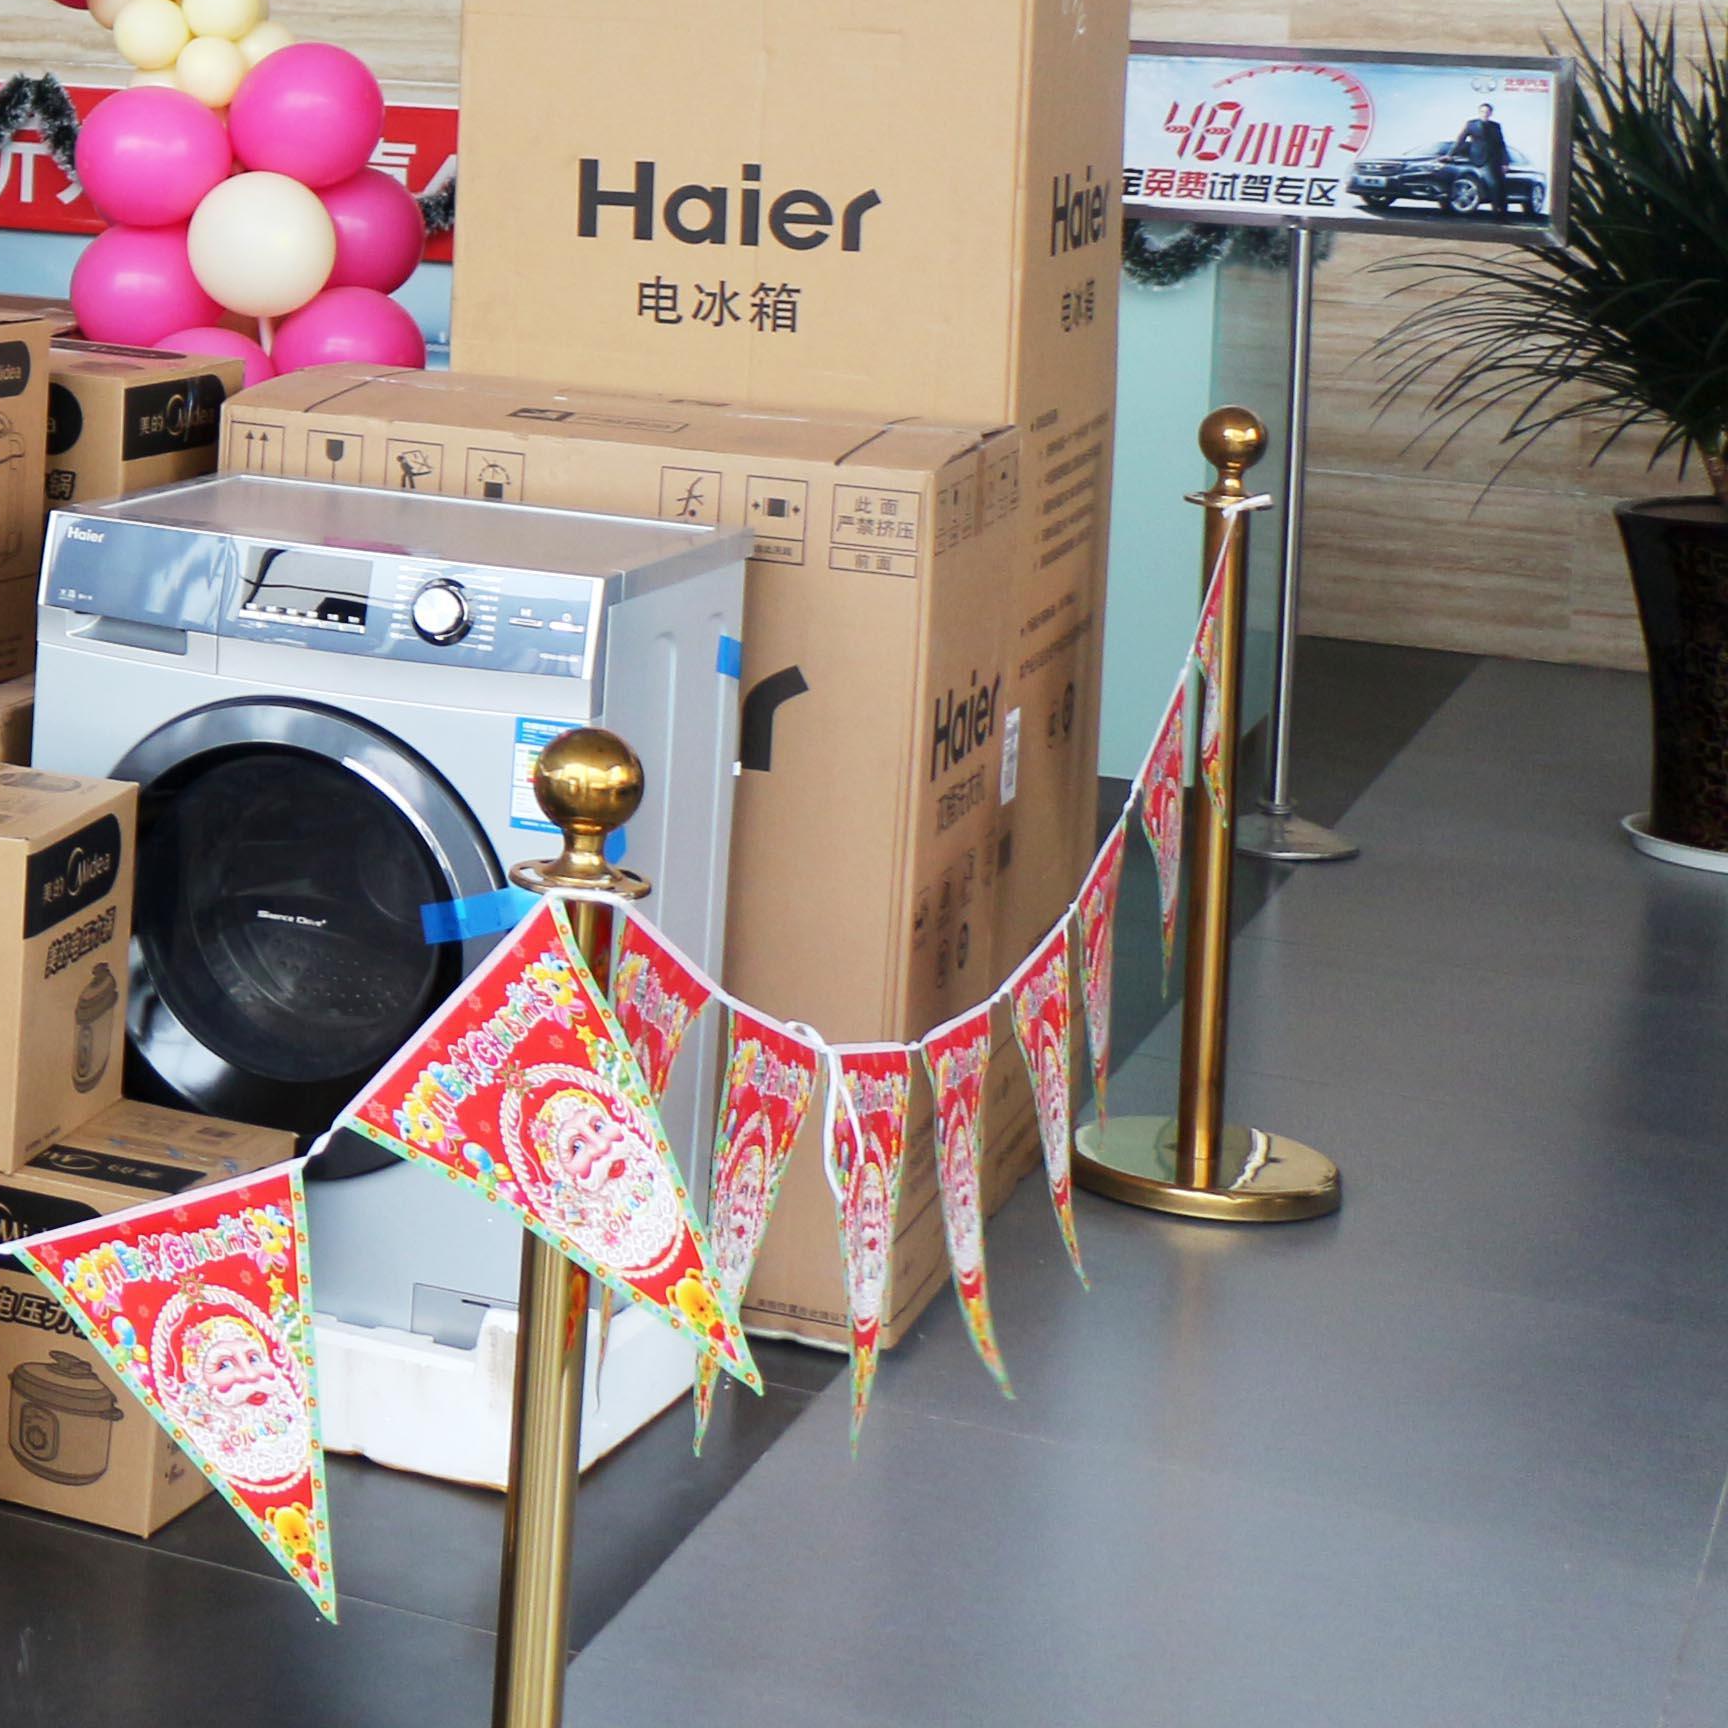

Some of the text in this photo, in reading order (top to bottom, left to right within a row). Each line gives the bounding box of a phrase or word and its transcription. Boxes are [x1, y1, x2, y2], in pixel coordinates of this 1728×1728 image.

[1163, 100, 1336, 169] 48小时
[577, 158, 883, 253] Haier
[1050, 164, 1112, 258] Haier
[637, 274, 803, 334] 电冰箱
[138, 413, 165, 438] 美的
[66, 526, 106, 545] Haier
[835, 515, 914, 540] 严禁挤压
[853, 496, 899, 517] 此面
[853, 553, 893, 572] 前面
[931, 668, 1002, 782] Haier
[42, 846, 111, 903] 美的 Midea
[426, 972, 558, 1124] MERRY CHRISTMAS
[93, 1214, 266, 1291] MERRY CHRISTMAS
